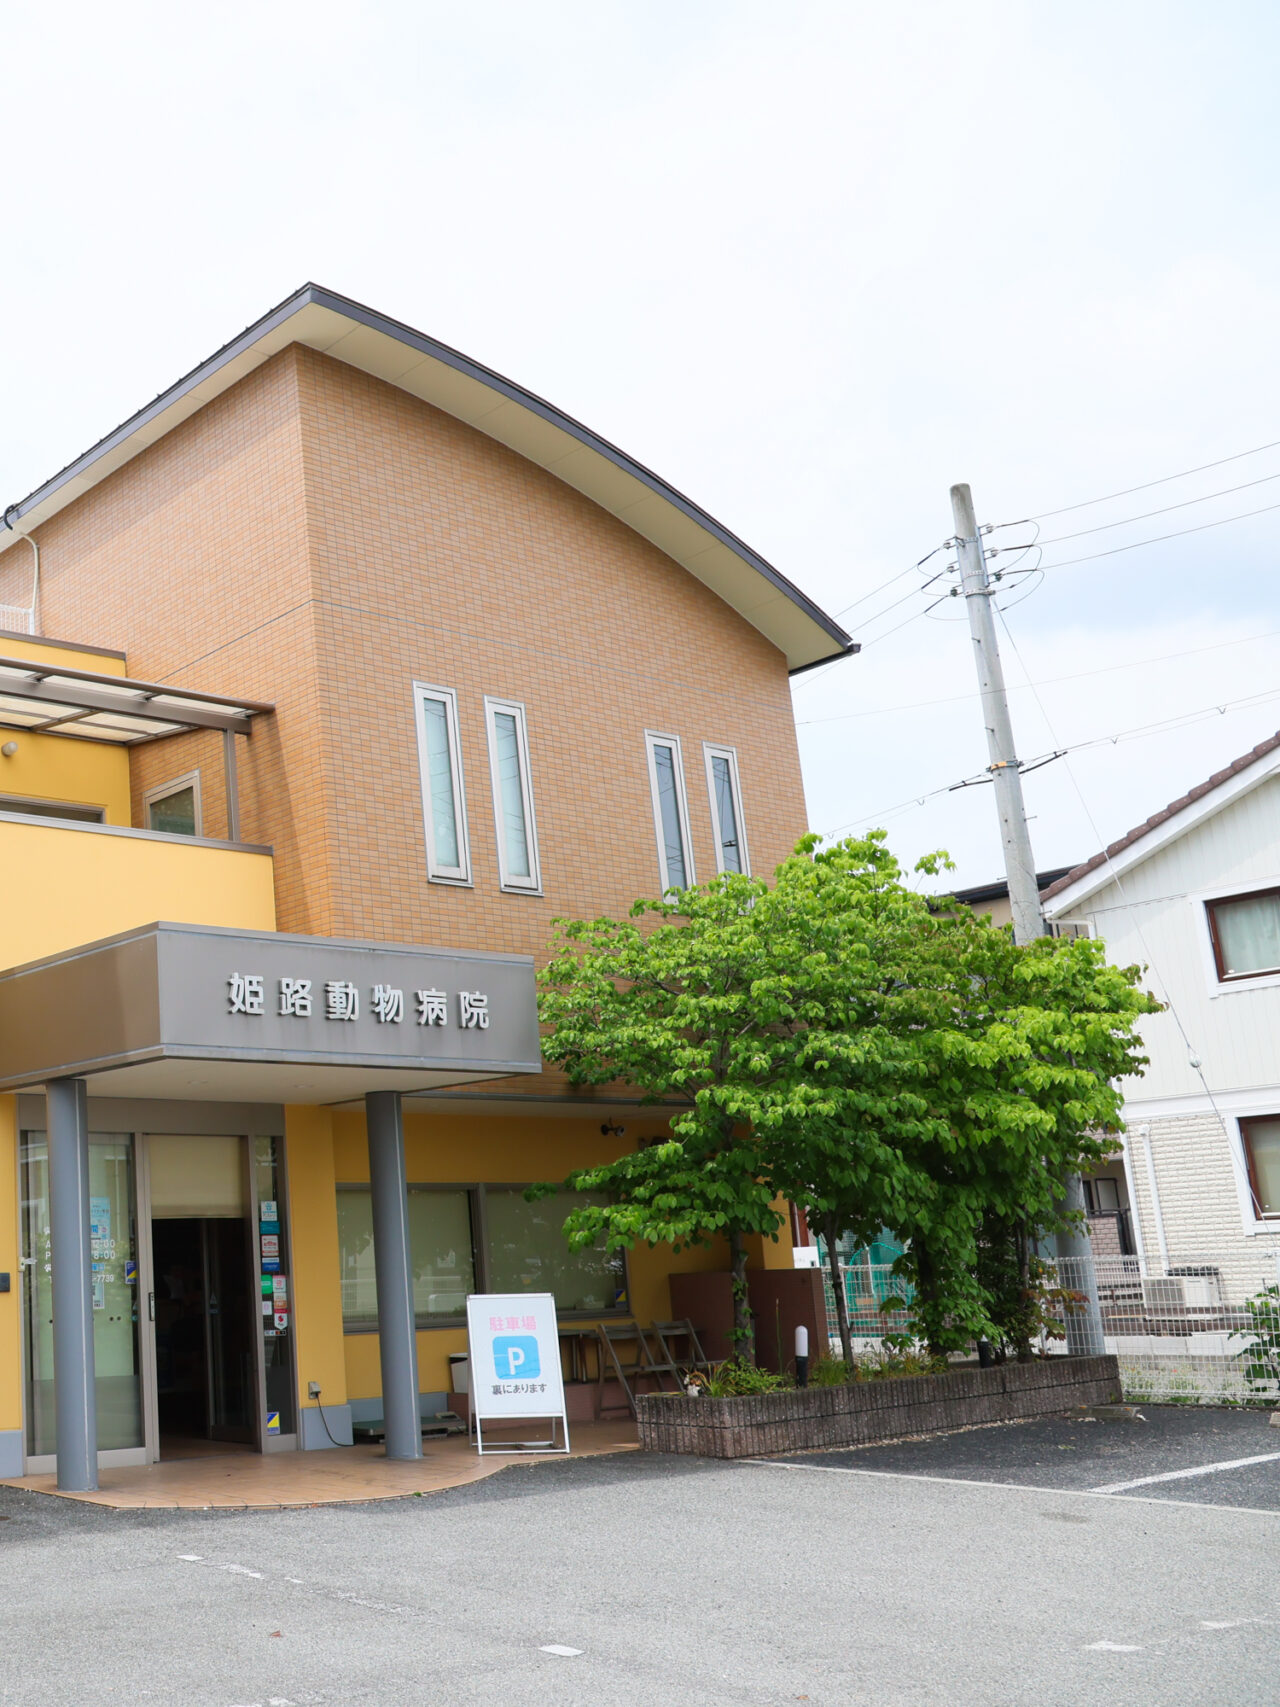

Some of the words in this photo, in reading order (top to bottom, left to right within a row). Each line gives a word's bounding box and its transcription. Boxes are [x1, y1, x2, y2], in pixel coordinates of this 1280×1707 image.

[228, 972, 490, 1029] 姫路動物病院
[489, 1316, 537, 1331] 駐車場
[507, 1347, 525, 1376] P
[492, 1384, 547, 1395] 裏にあります
